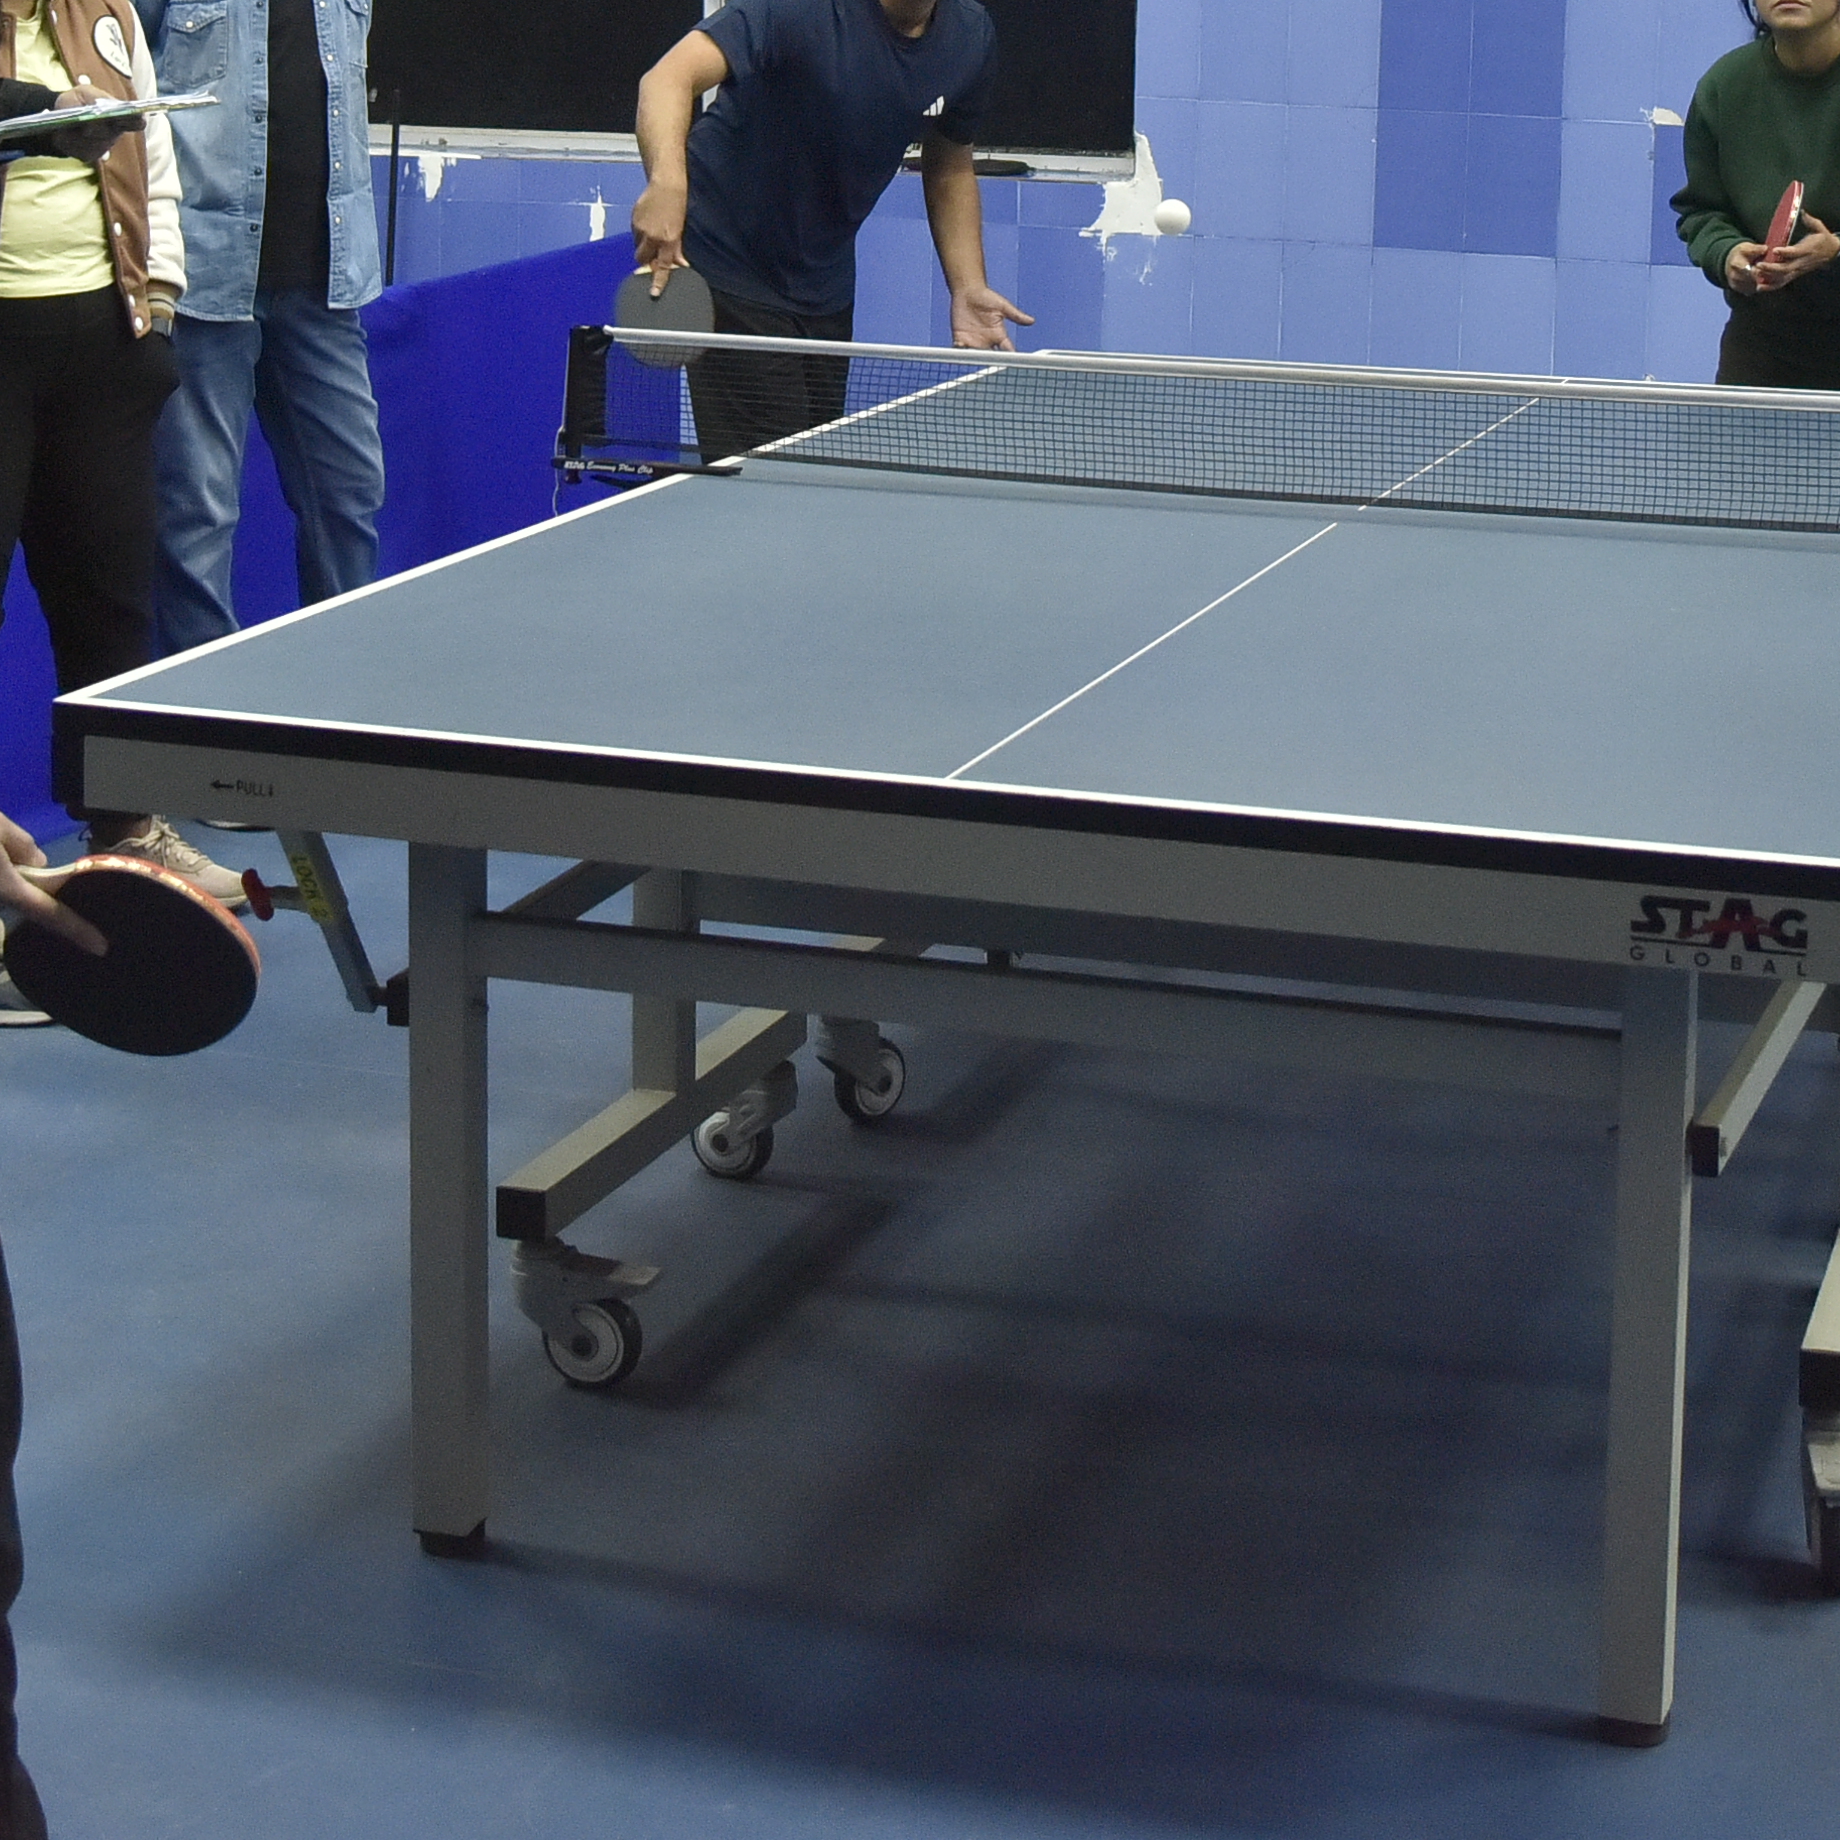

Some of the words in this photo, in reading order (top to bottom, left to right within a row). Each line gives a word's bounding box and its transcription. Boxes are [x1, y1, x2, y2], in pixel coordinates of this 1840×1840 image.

[236, 779, 266, 797] PULL
[1630, 894, 1808, 950] STAG
[1629, 945, 1809, 977] GLOBAL
